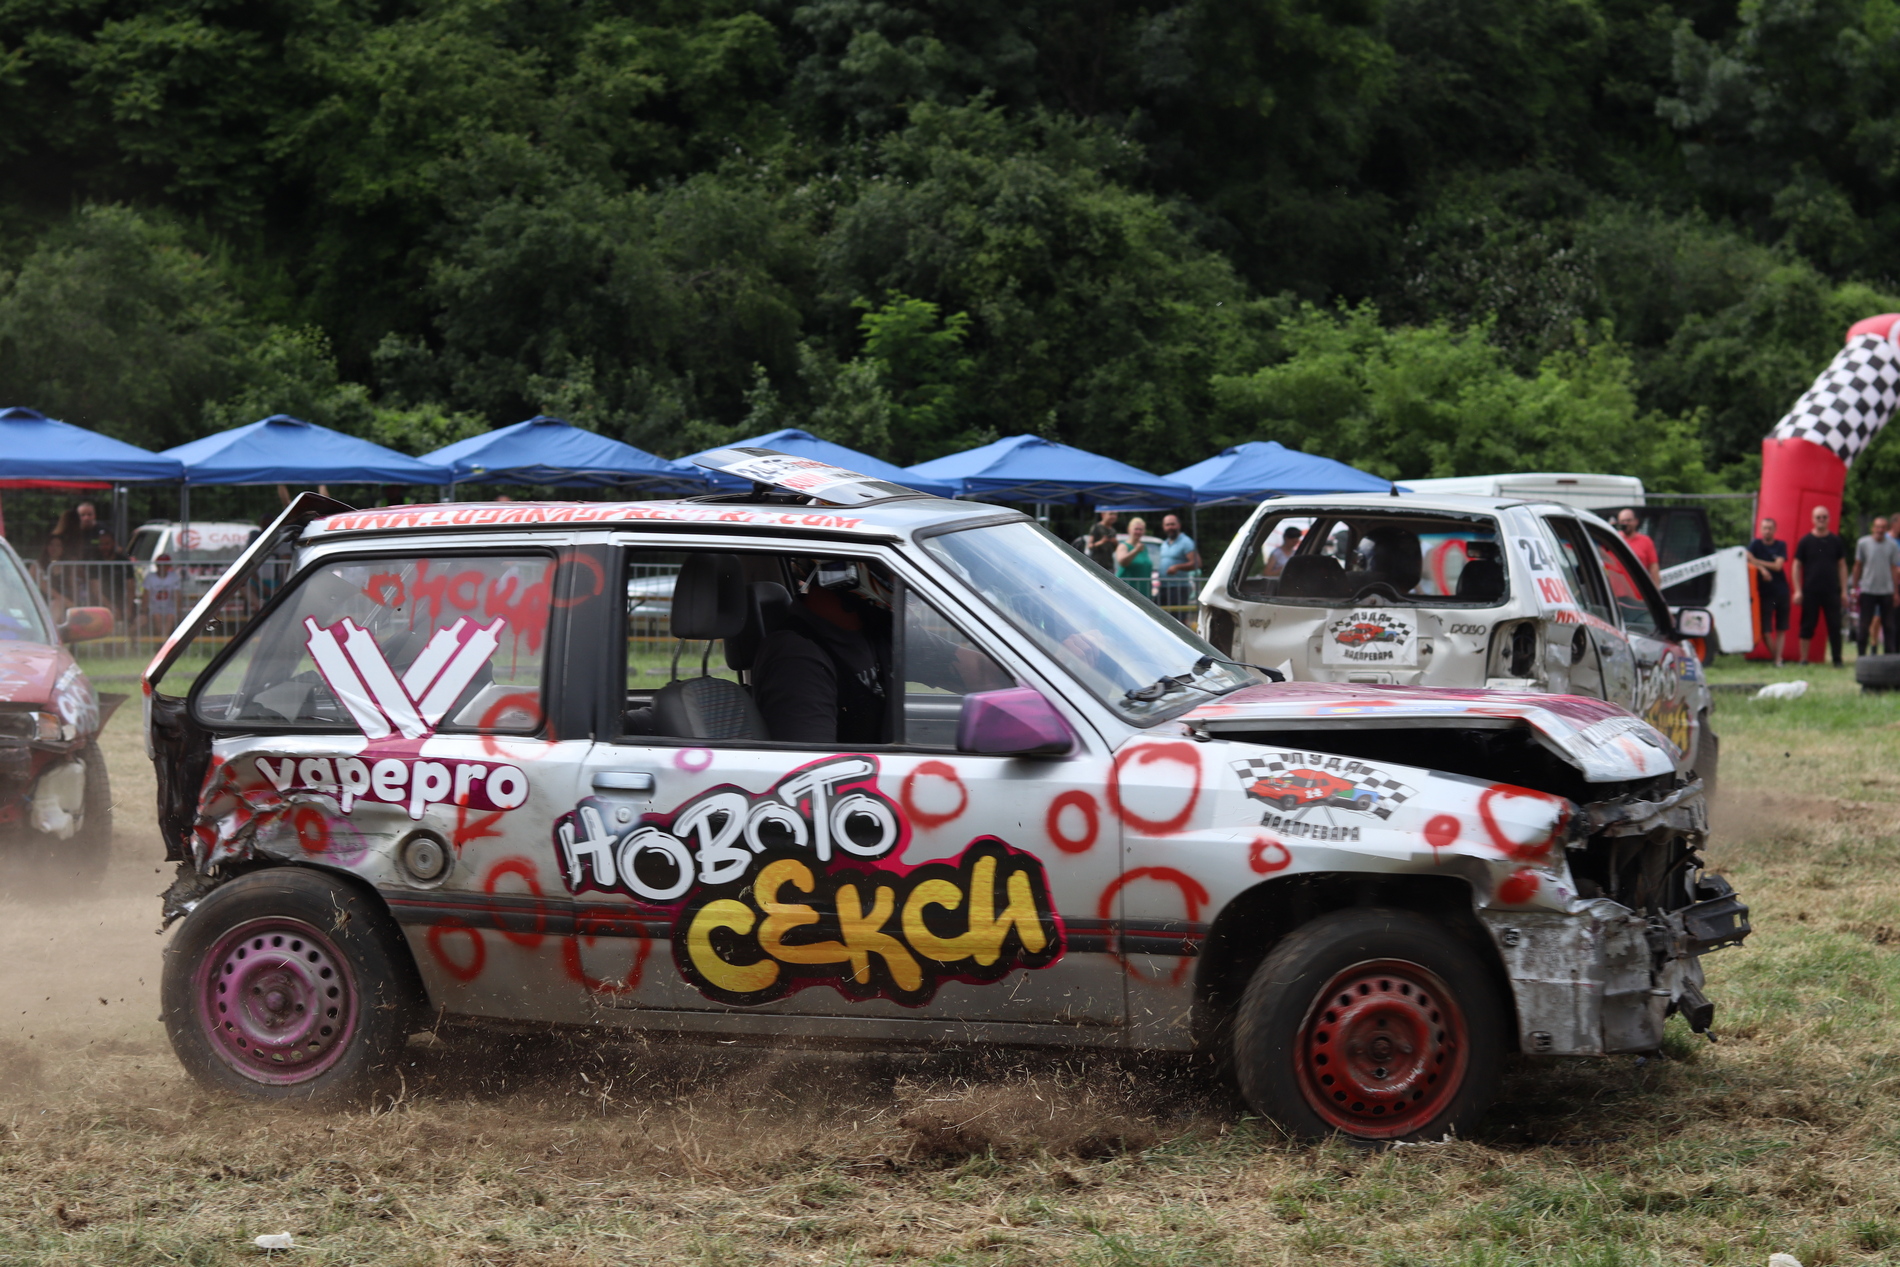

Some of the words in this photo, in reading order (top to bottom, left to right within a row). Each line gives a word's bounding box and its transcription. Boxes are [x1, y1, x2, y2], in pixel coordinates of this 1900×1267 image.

[256, 758, 529, 820] vapepro
[1290, 752, 1362, 774] ЛУДА
[688, 856, 1047, 993] СЕКСИ
